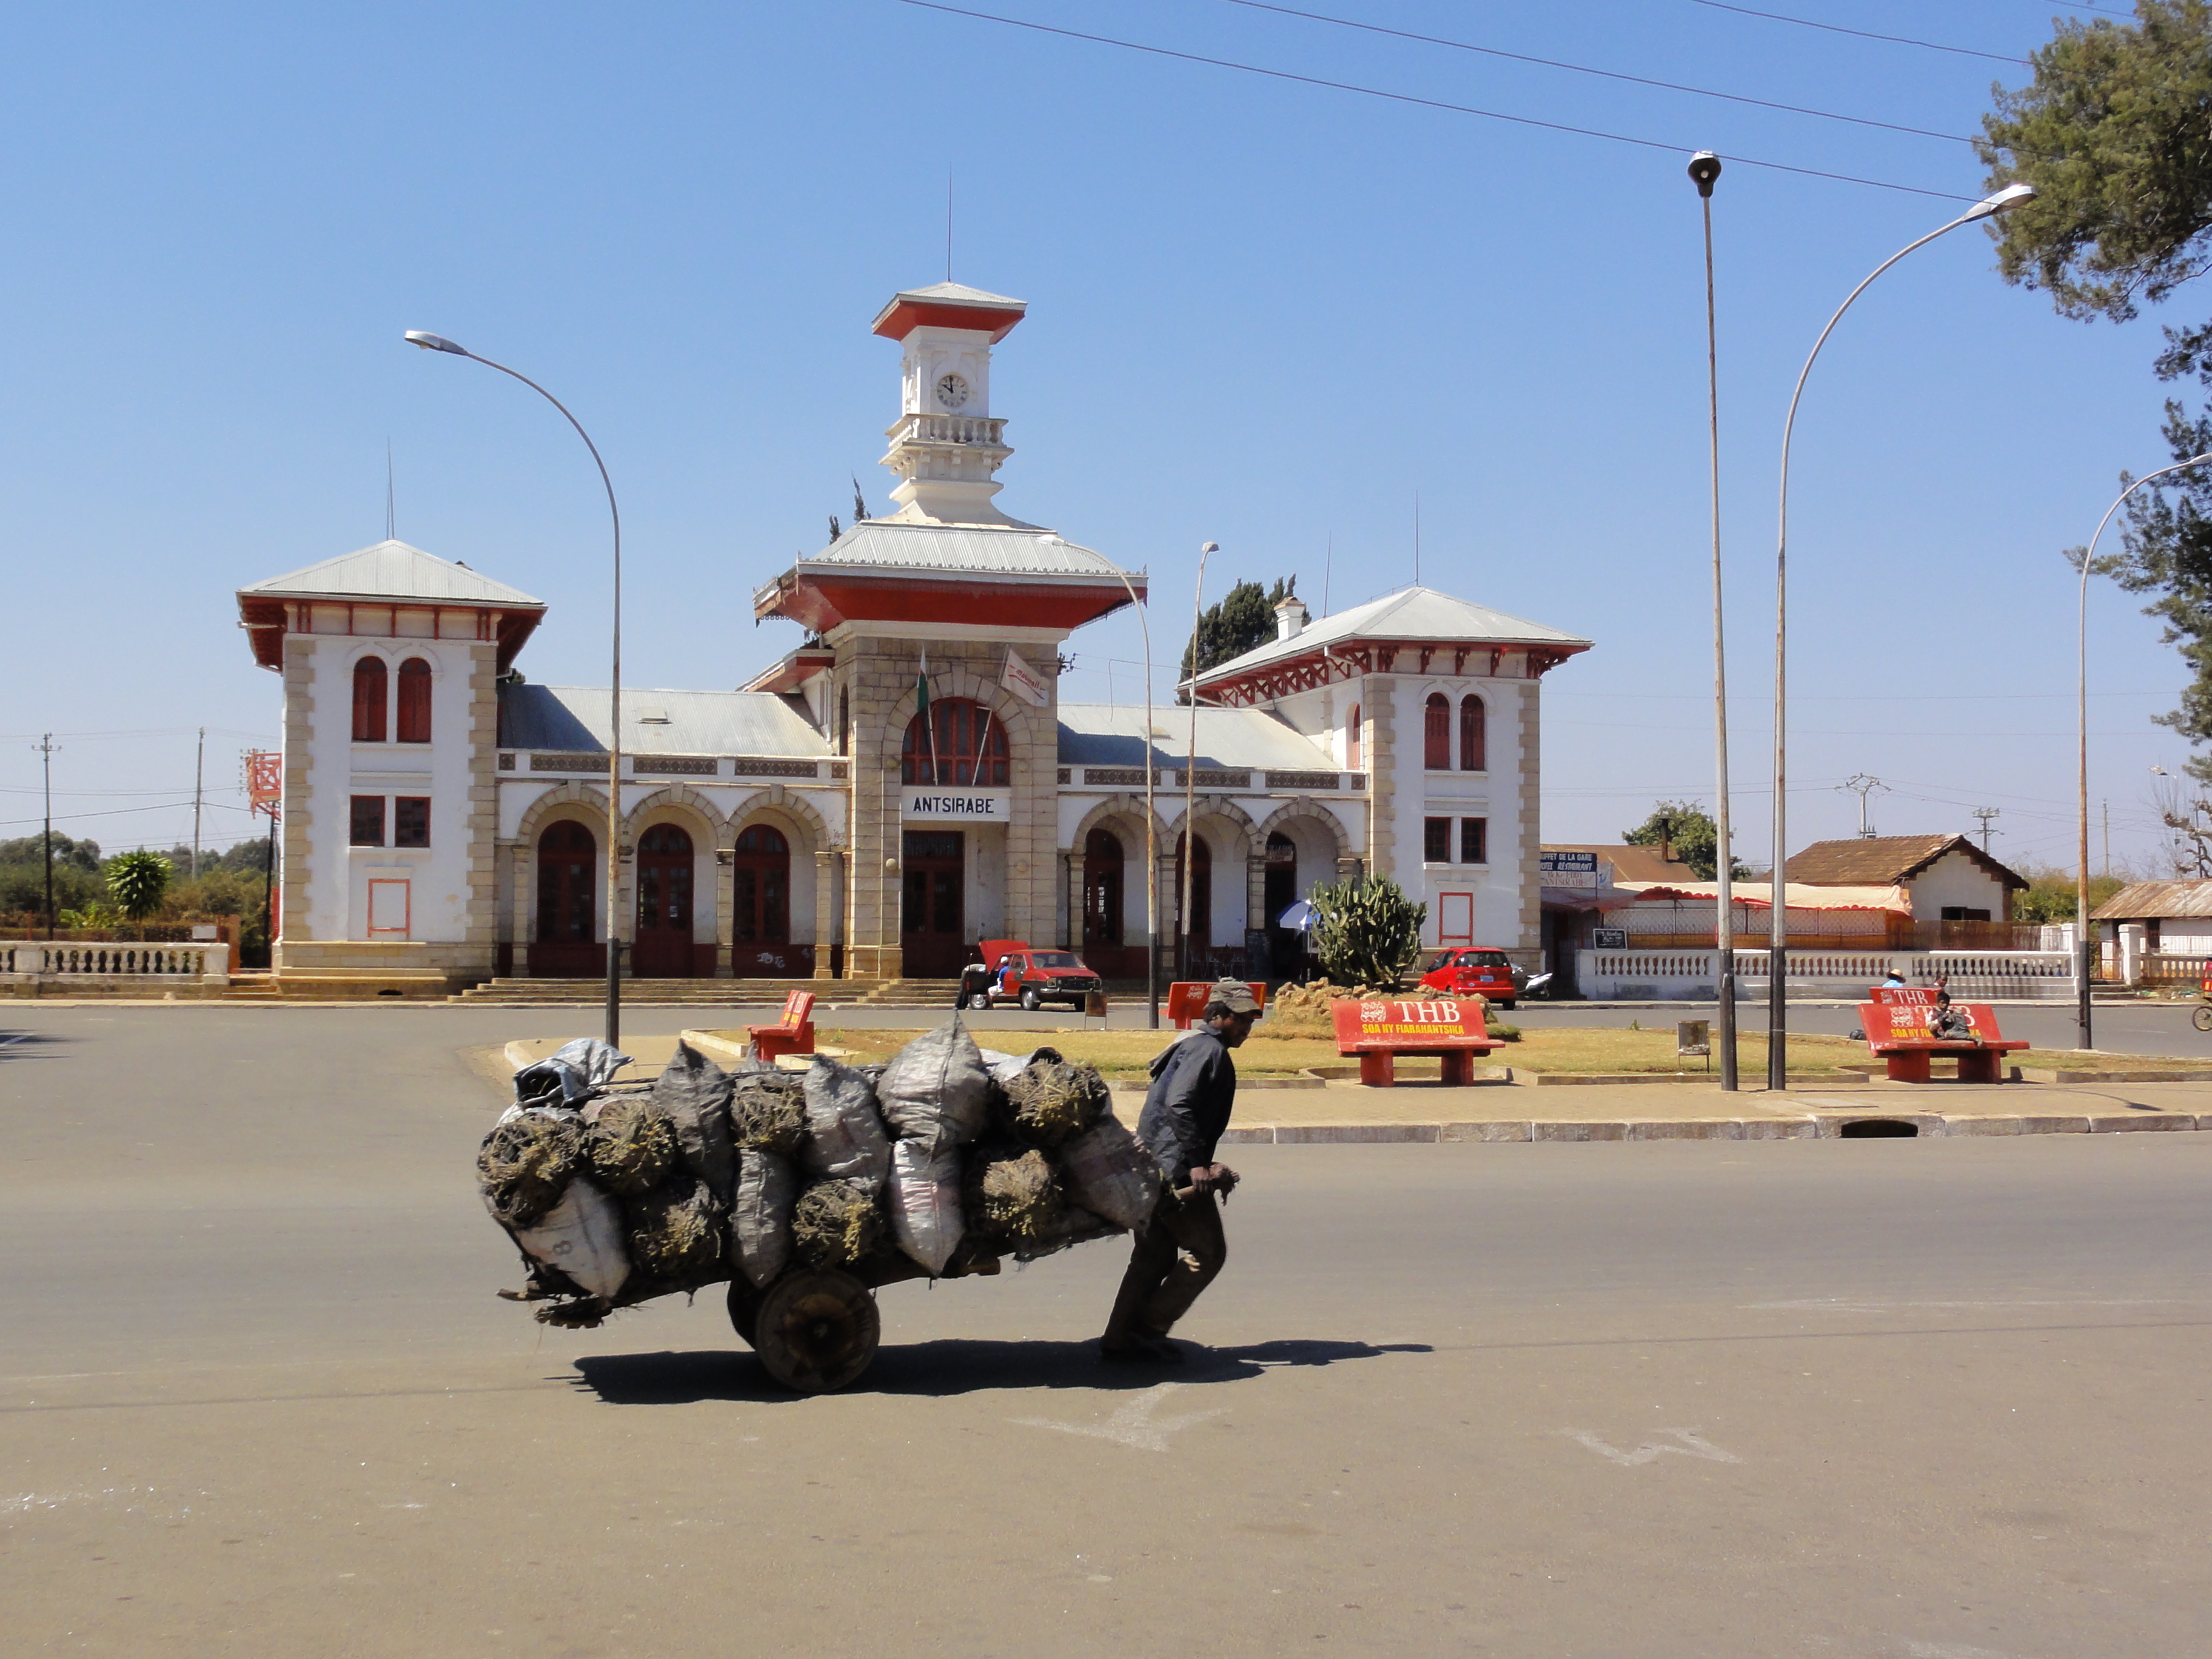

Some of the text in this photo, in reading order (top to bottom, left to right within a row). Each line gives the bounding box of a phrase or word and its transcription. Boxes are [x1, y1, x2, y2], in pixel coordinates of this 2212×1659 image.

[913, 797, 994, 813] ANTSIRABE
[1541, 862, 1553, 870] OTEL
[1393, 1001, 1460, 1023] THB
[1362, 1024, 1464, 1034] SOA NY FIARAHANTSIKA
[1891, 1028, 1908, 1037] SOA
[1908, 1029, 1919, 1037] NY
